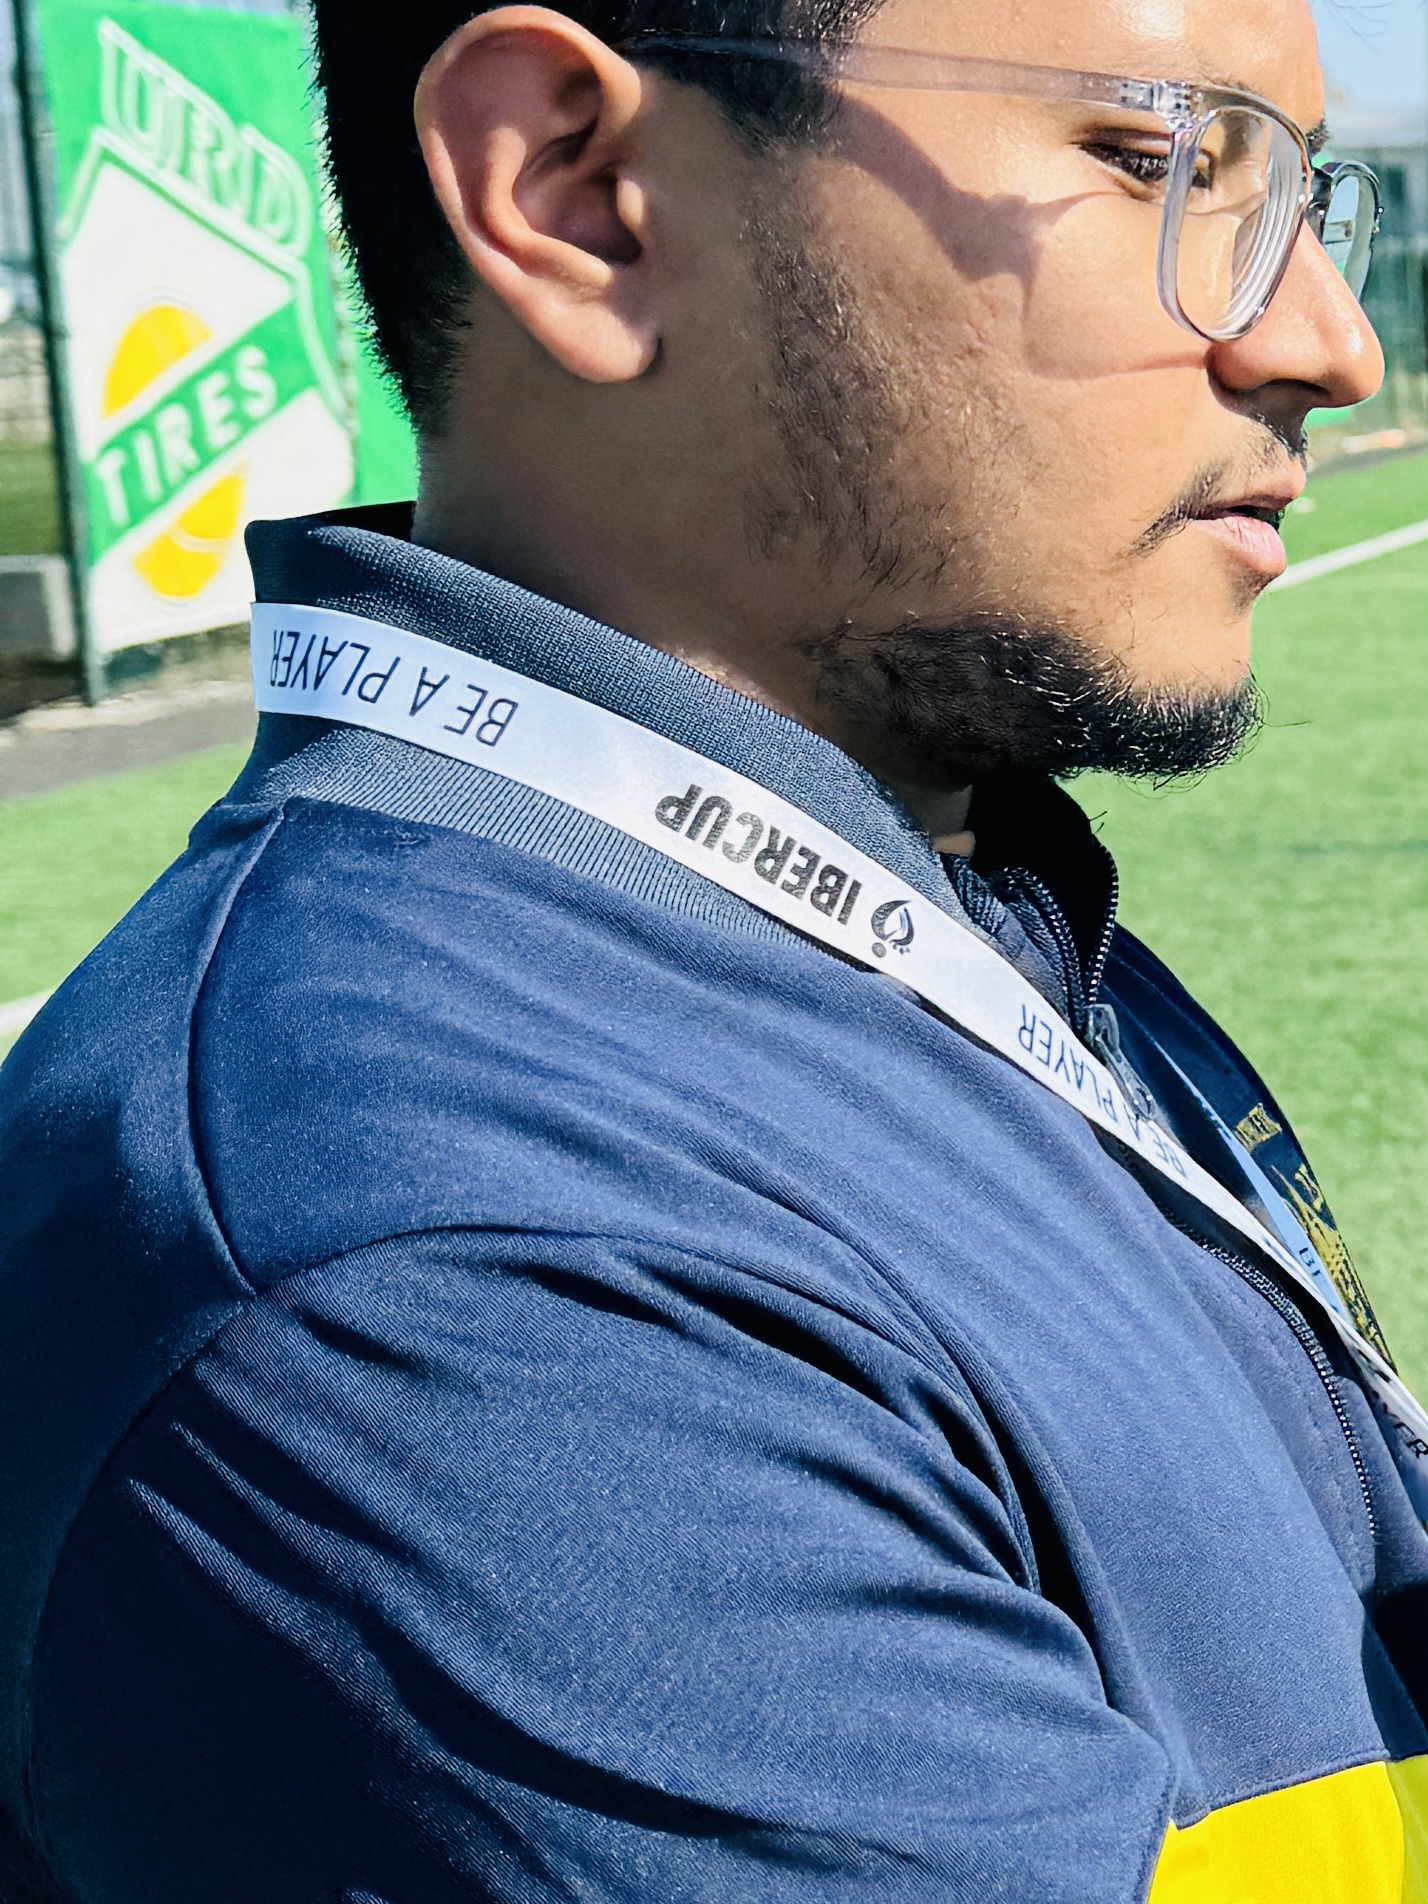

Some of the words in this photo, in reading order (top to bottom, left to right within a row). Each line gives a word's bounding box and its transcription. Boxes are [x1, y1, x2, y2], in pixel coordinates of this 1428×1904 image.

[97, 345, 278, 528] TIRES
[270, 630, 401, 703] PLAYER
[408, 667, 450, 716] A
[443, 684, 519, 746] BE
[655, 783, 862, 926] IBERCUP
[1018, 1004, 1118, 1124] PLAYER
[1122, 1104, 1141, 1142] A
[1151, 1127, 1187, 1178] BE
